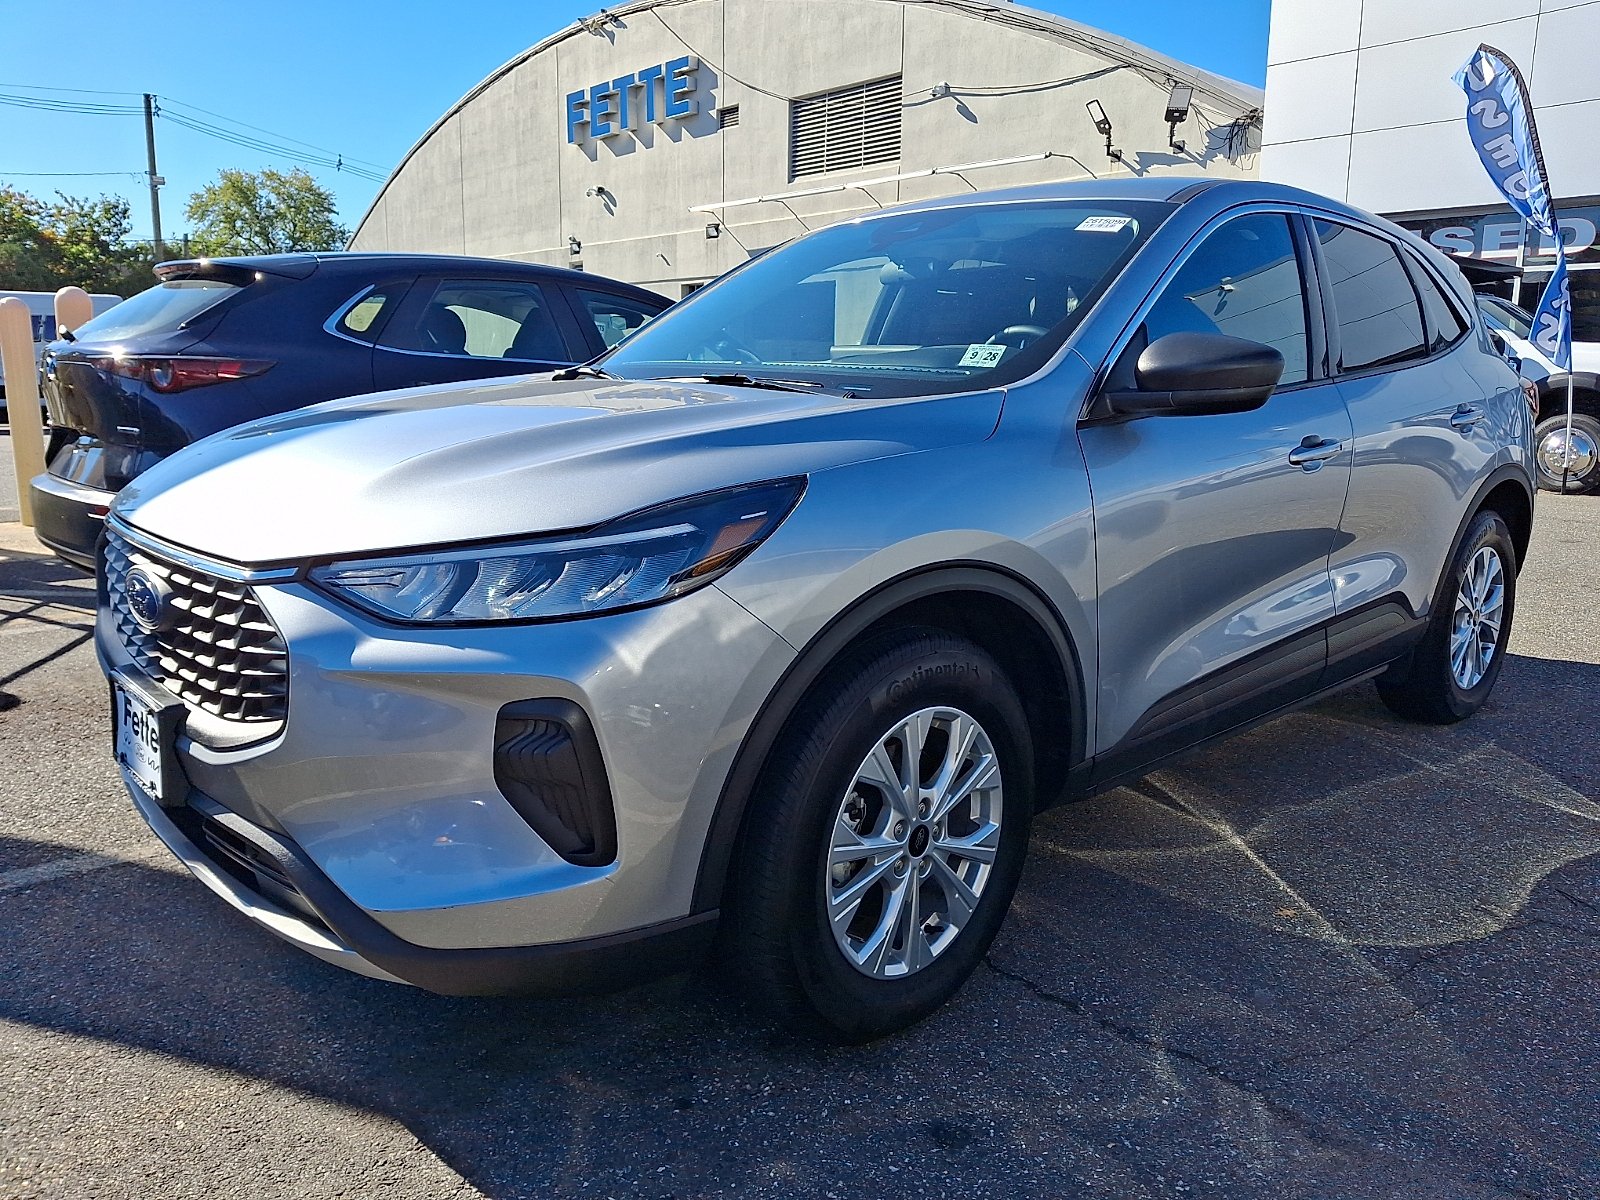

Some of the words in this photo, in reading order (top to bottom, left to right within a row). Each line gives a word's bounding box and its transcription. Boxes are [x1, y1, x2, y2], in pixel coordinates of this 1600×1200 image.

[566, 55, 695, 145] FETTE
[1411, 217, 1597, 259] SED
[970, 351, 979, 360] 9
[983, 352, 999, 362] 28
[123, 694, 159, 754] Fette
